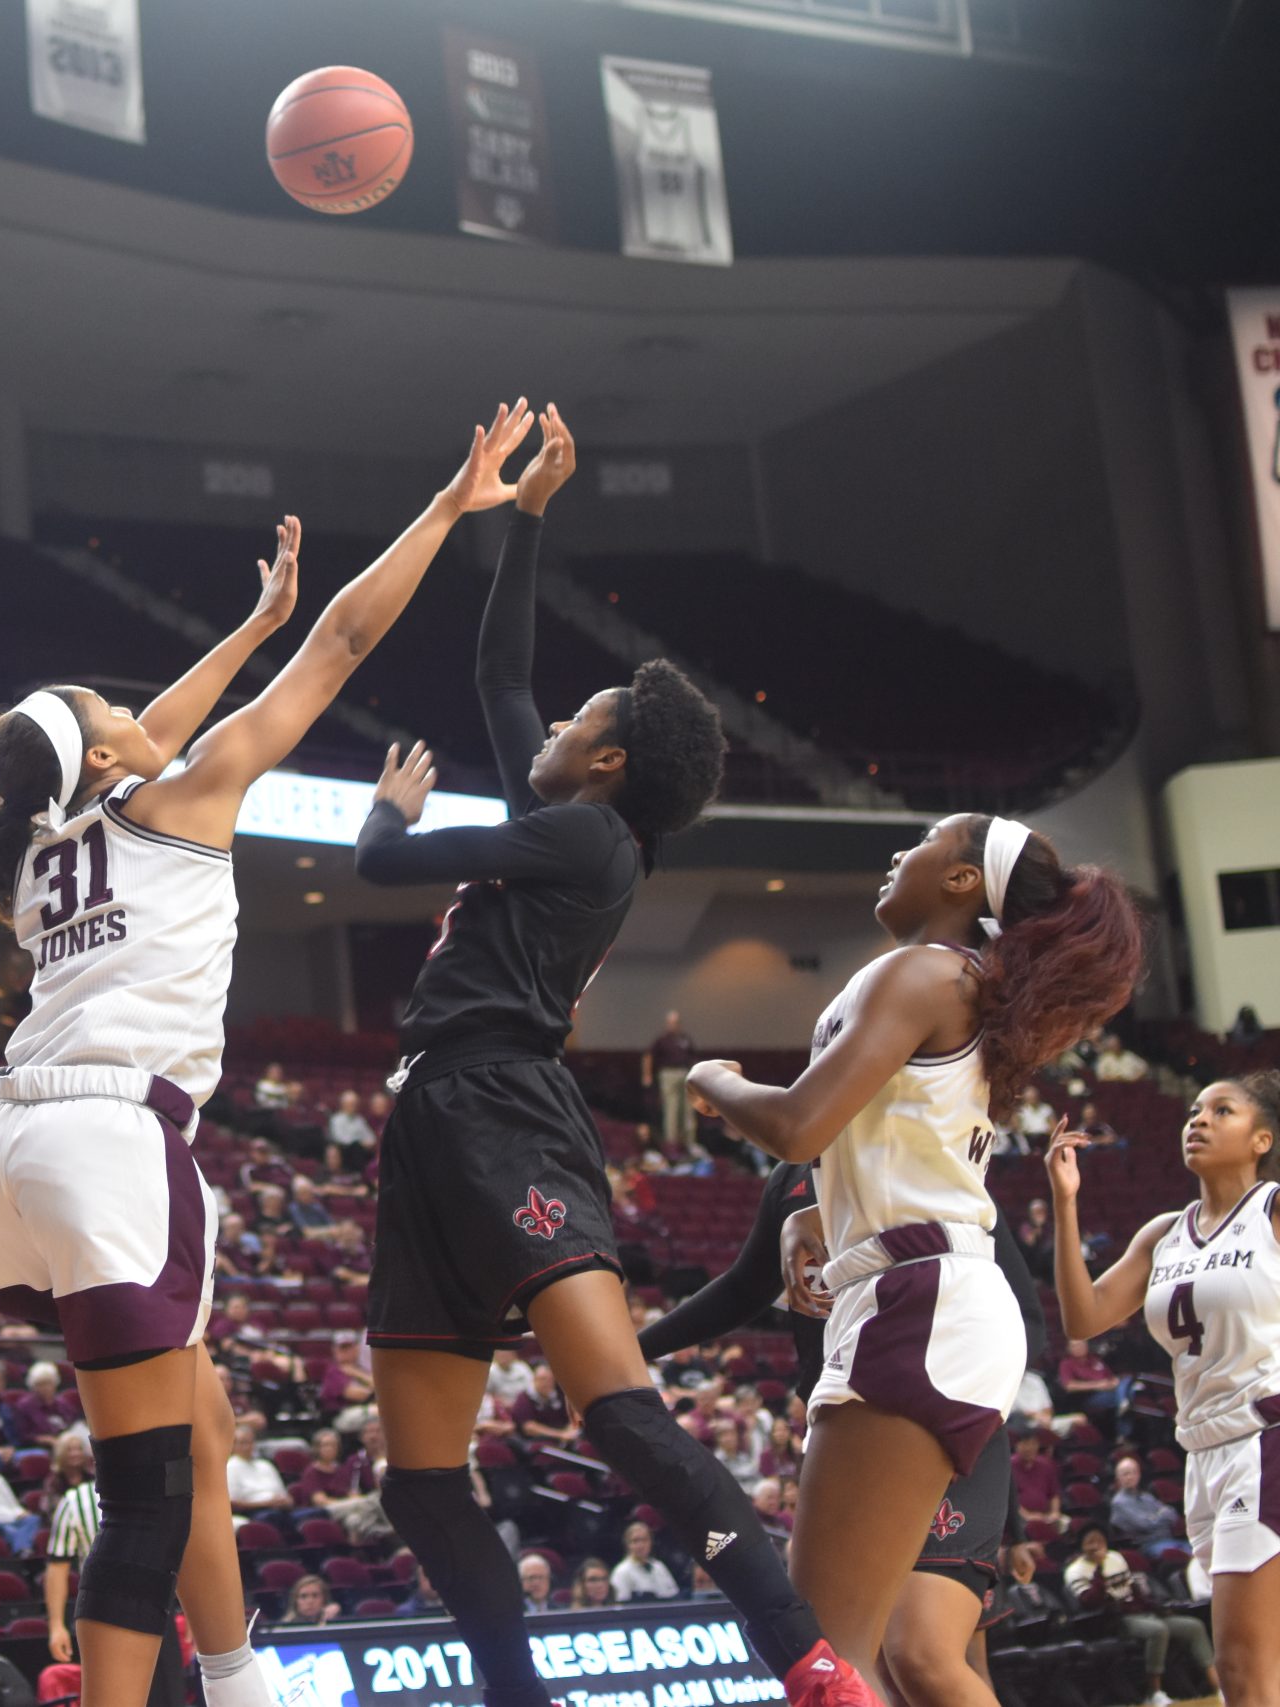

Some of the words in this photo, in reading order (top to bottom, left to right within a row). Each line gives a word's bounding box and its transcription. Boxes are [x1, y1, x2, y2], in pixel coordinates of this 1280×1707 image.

[33, 820, 113, 931] 31
[37, 909, 127, 971] JONES
[1151, 1258, 1201, 1287] EXAS
[1203, 1249, 1255, 1271] A&M
[1168, 1281, 1205, 1356] 4
[705, 1531, 738, 1561] adidas
[363, 1641, 475, 1693] 2017
[528, 1621, 750, 1680] RESEASON
[652, 1679, 714, 1707] A&M
[712, 1674, 787, 1705] Unive
